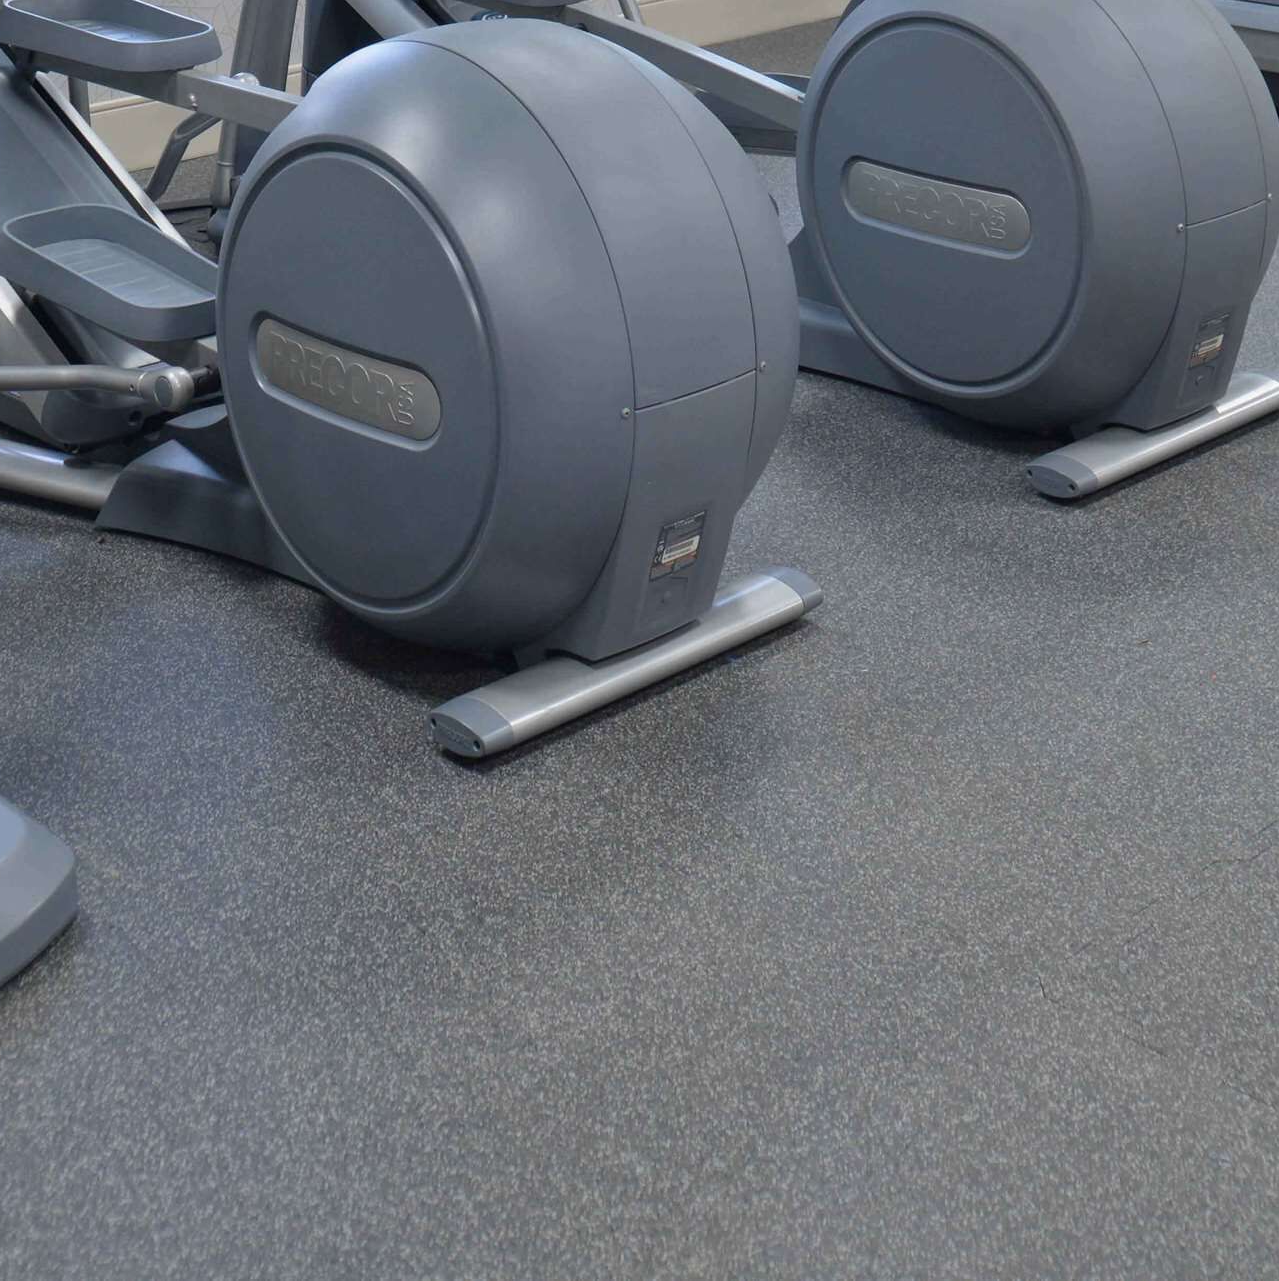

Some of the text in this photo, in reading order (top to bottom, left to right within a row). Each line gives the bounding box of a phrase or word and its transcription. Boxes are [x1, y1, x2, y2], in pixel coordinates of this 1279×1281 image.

[862, 170, 990, 239] PRECOR
[269, 329, 398, 423] PRECOR
[396, 381, 416, 425] USA
